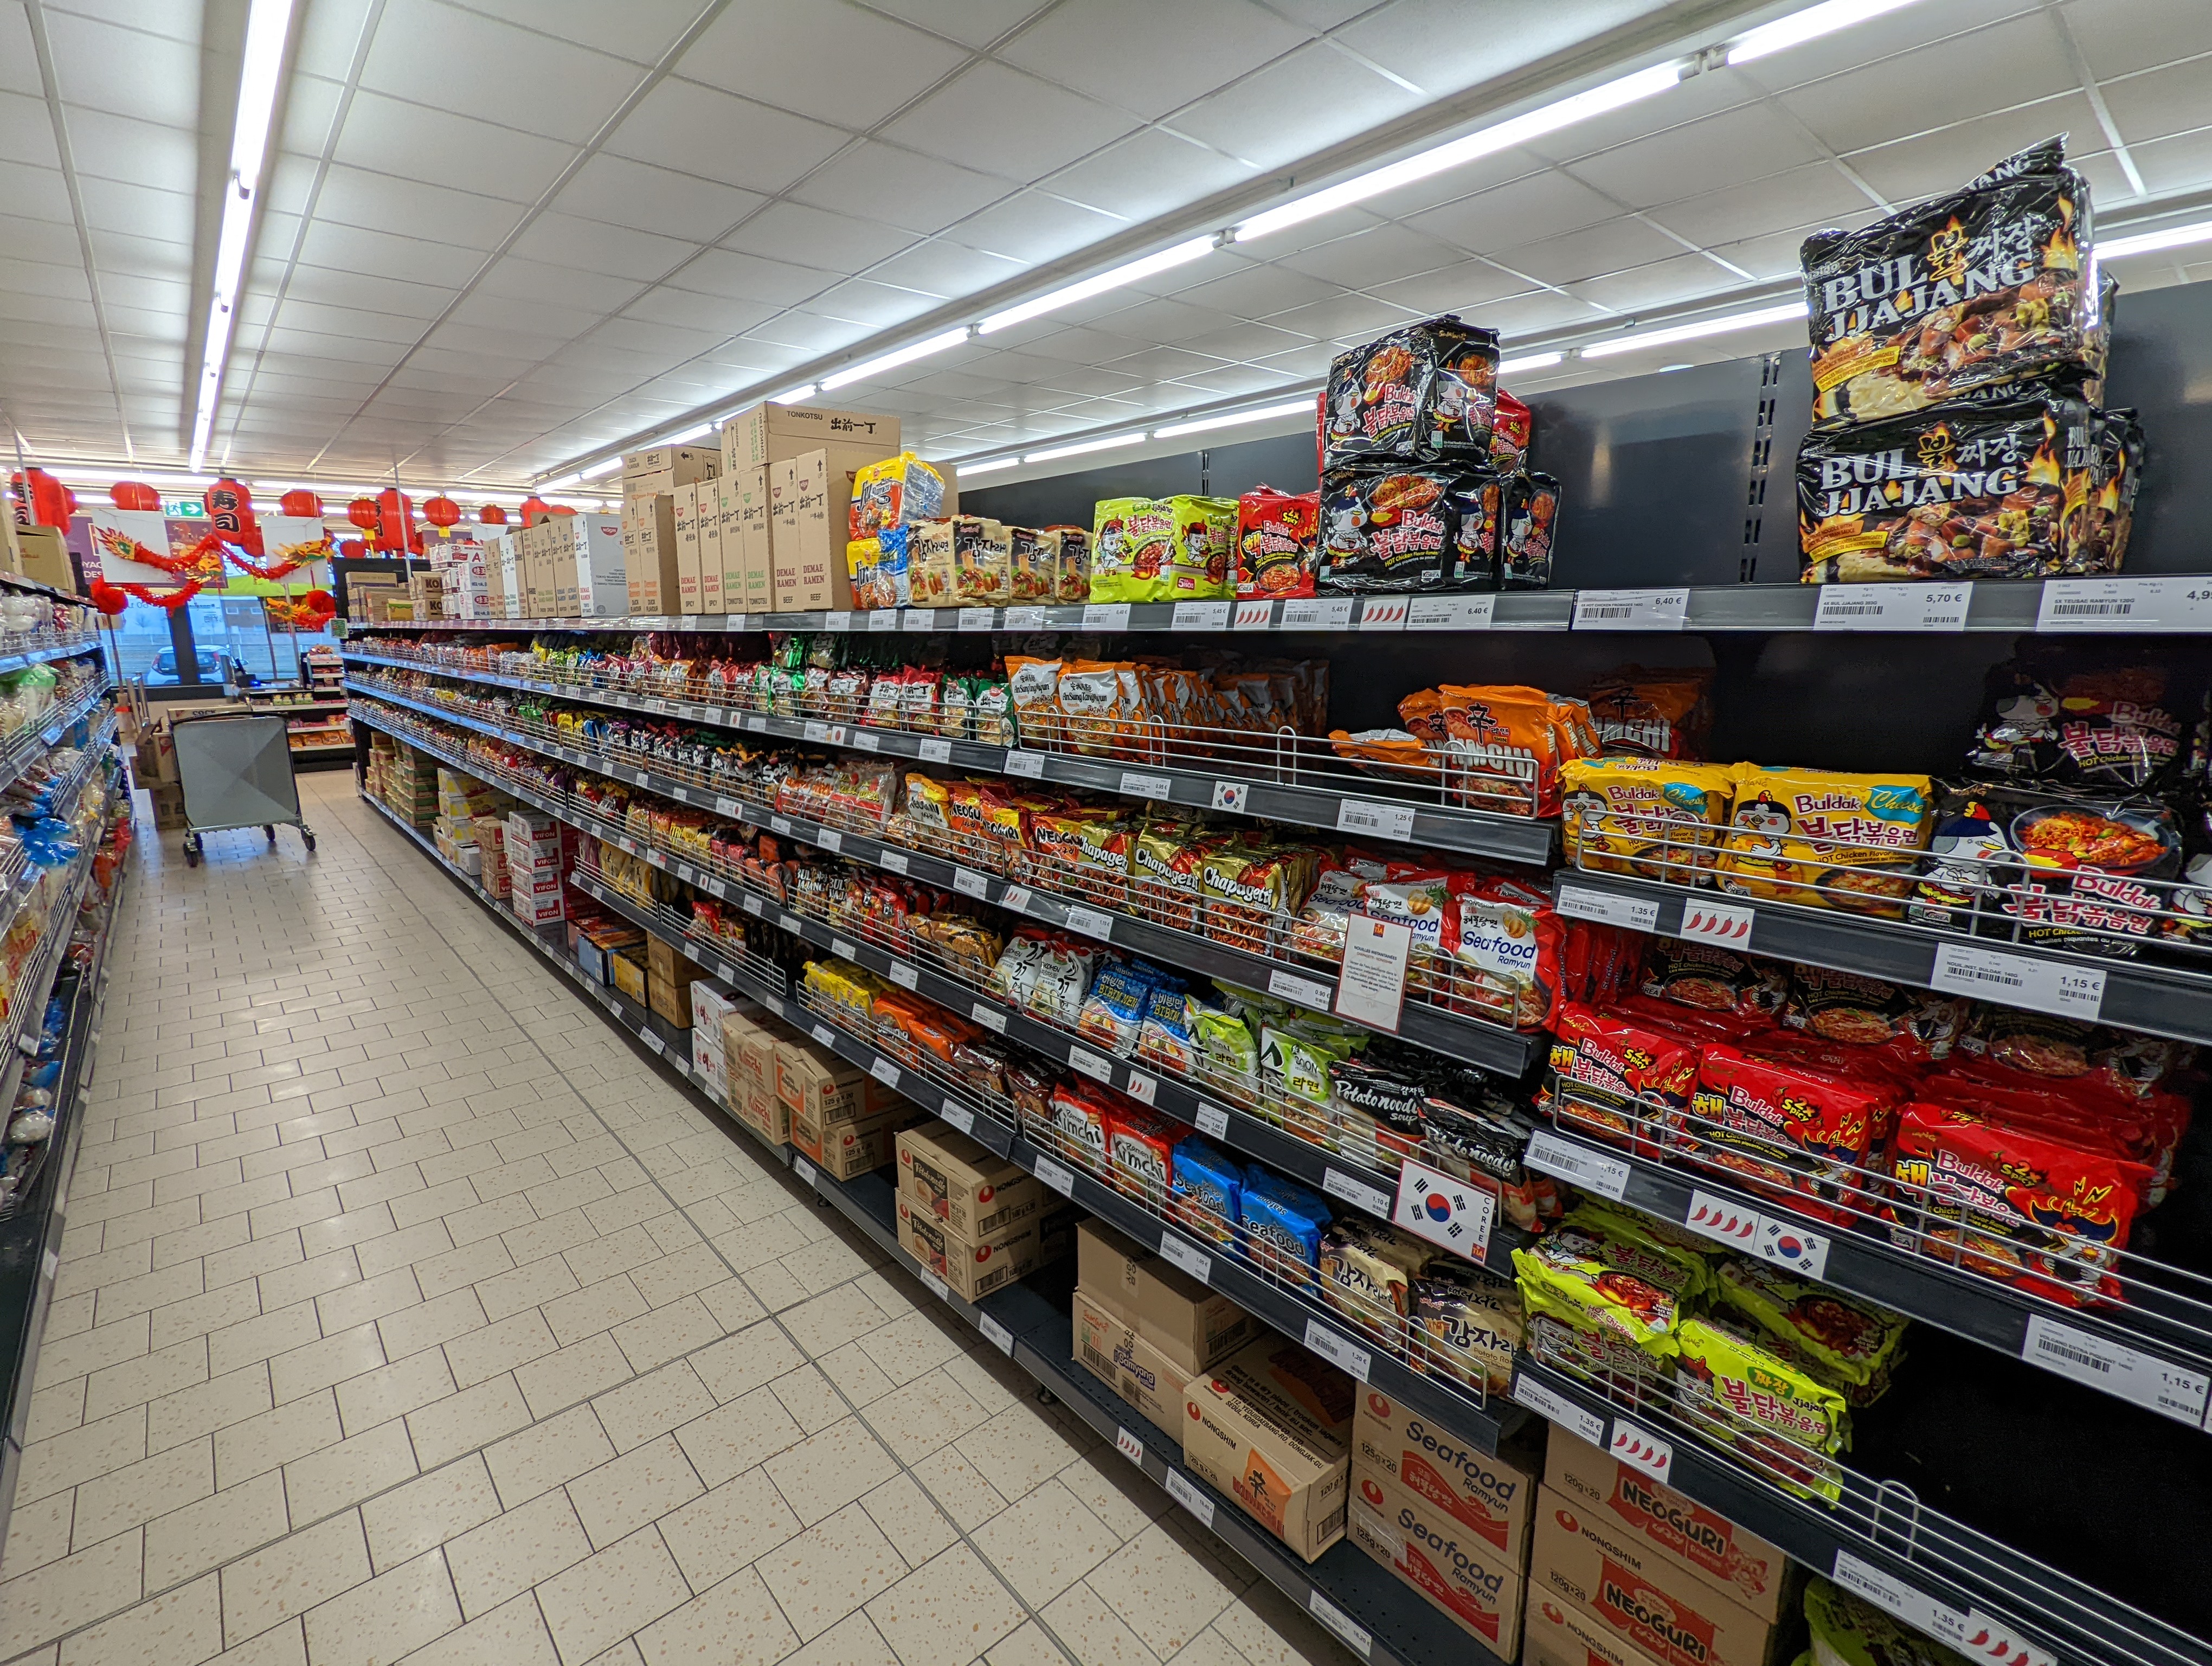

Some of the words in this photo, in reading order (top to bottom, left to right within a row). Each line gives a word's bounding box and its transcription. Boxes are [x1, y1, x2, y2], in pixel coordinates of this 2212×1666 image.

[1969, 217, 2036, 264] 짜장
[1824, 254, 1928, 315] BUL
[1824, 253, 2035, 342] JJAJANG
[787, 411, 823, 420] TONKOTSU
[831, 418, 876, 434] 出前一丁
[1957, 433, 2022, 467] 짜장
[1821, 448, 1915, 490] BUL
[800, 493, 824, 510] 出前一丁
[1819, 466, 2017, 517] JJAJANG
[773, 501, 795, 516] 出前一丁
[1264, 521, 1288, 535] Buldak
[1283, 515, 1297, 525] Spicy
[1401, 510, 1443, 534] Buldak
[914, 538, 949, 555] 감자라면
[1371, 530, 1441, 560] 불닭볶음면
[803, 564, 824, 573] DEMAE
[1385, 559, 1395, 567] HOT
[1396, 555, 1413, 563] Chicken
[704, 575, 718, 583] DEMAE
[748, 571, 764, 579] DEMAE
[776, 568, 795, 576] DEMAE
[803, 575, 825, 585] RAMEN
[681, 585, 697, 594] RAMEN
[705, 584, 719, 592] RAMEN
[726, 581, 741, 589] RAMEN
[748, 581, 765, 589] RAMEN
[777, 578, 796, 587] RAMEN
[1926, 594, 1950, 604] 5,70
[1954, 594, 1962, 602] €
[1467, 703, 1496, 745] 辛
[1490, 727, 1509, 735] 라면
[1606, 786, 1661, 802] Buldak
[1795, 794, 1861, 814] Buldak
[1870, 792, 1924, 818] Cheese
[1797, 816, 1919, 854] 불닭볶음면
[1203, 866, 1273, 905] Chapagetti
[2072, 864, 2162, 911] Buldak
[1924, 911, 1951, 922] KOREA
[1463, 930, 1536, 960] Seafood
[1497, 955, 1531, 970] Ramyun
[1098, 983, 1122, 1002] BIBIN
[2060, 976, 2088, 988] 1,15
[2092, 982, 2100, 990] €
[1216, 1053, 1237, 1067] 라면
[1580, 1038, 1625, 1074] Buldak
[1623, 1049, 1647, 1070] Spicy
[1293, 1077, 1320, 1094] 라면
[1335, 1080, 1380, 1108] Potato
[824, 1097, 834, 1106] 125
[1731, 1086, 1784, 1126] Buldak
[1782, 1099, 1809, 1122] Spicy
[1066, 1109, 1084, 1124] Ramen
[1390, 1112, 1418, 1124] soup
[1126, 1142, 1149, 1159] Ramen
[1938, 1149, 2005, 1193] Buldak
[2000, 1163, 2036, 1187] Spicy
[1175, 1172, 1226, 1214] Seafood
[1473, 1247, 1484, 1257] TIA
[1588, 1305, 1606, 1318] HOT
[1606, 1315, 1636, 1340] Chicken
[1474, 1346, 1497, 1361] Potato
[2039, 1334, 2067, 1345] VOLCANO
[2068, 1344, 2088, 1354] EXTRA
[1754, 1369, 1789, 1395] 짜장
[2195, 1385, 2204, 1394] €
[1225, 1400, 1243, 1417] SEOUL,
[1243, 1414, 1261, 1429] KOREA
[1719, 1375, 1827, 1436] 불닭볶음면
[1202, 1416, 1236, 1450] NONGSHIM
[1406, 1420, 1517, 1502] Seafood
[1463, 1477, 1508, 1514] Ramyun
[1621, 1478, 1726, 1555] NEOGURI
[1398, 1508, 1504, 1592] Seafood
[1581, 1526, 1642, 1570] NONGSHIM
[1452, 1568, 1496, 1605] Ramyun
[1604, 1581, 1707, 1663] NEOGURI
[1566, 1621, 1624, 1665] NONGSHIM
